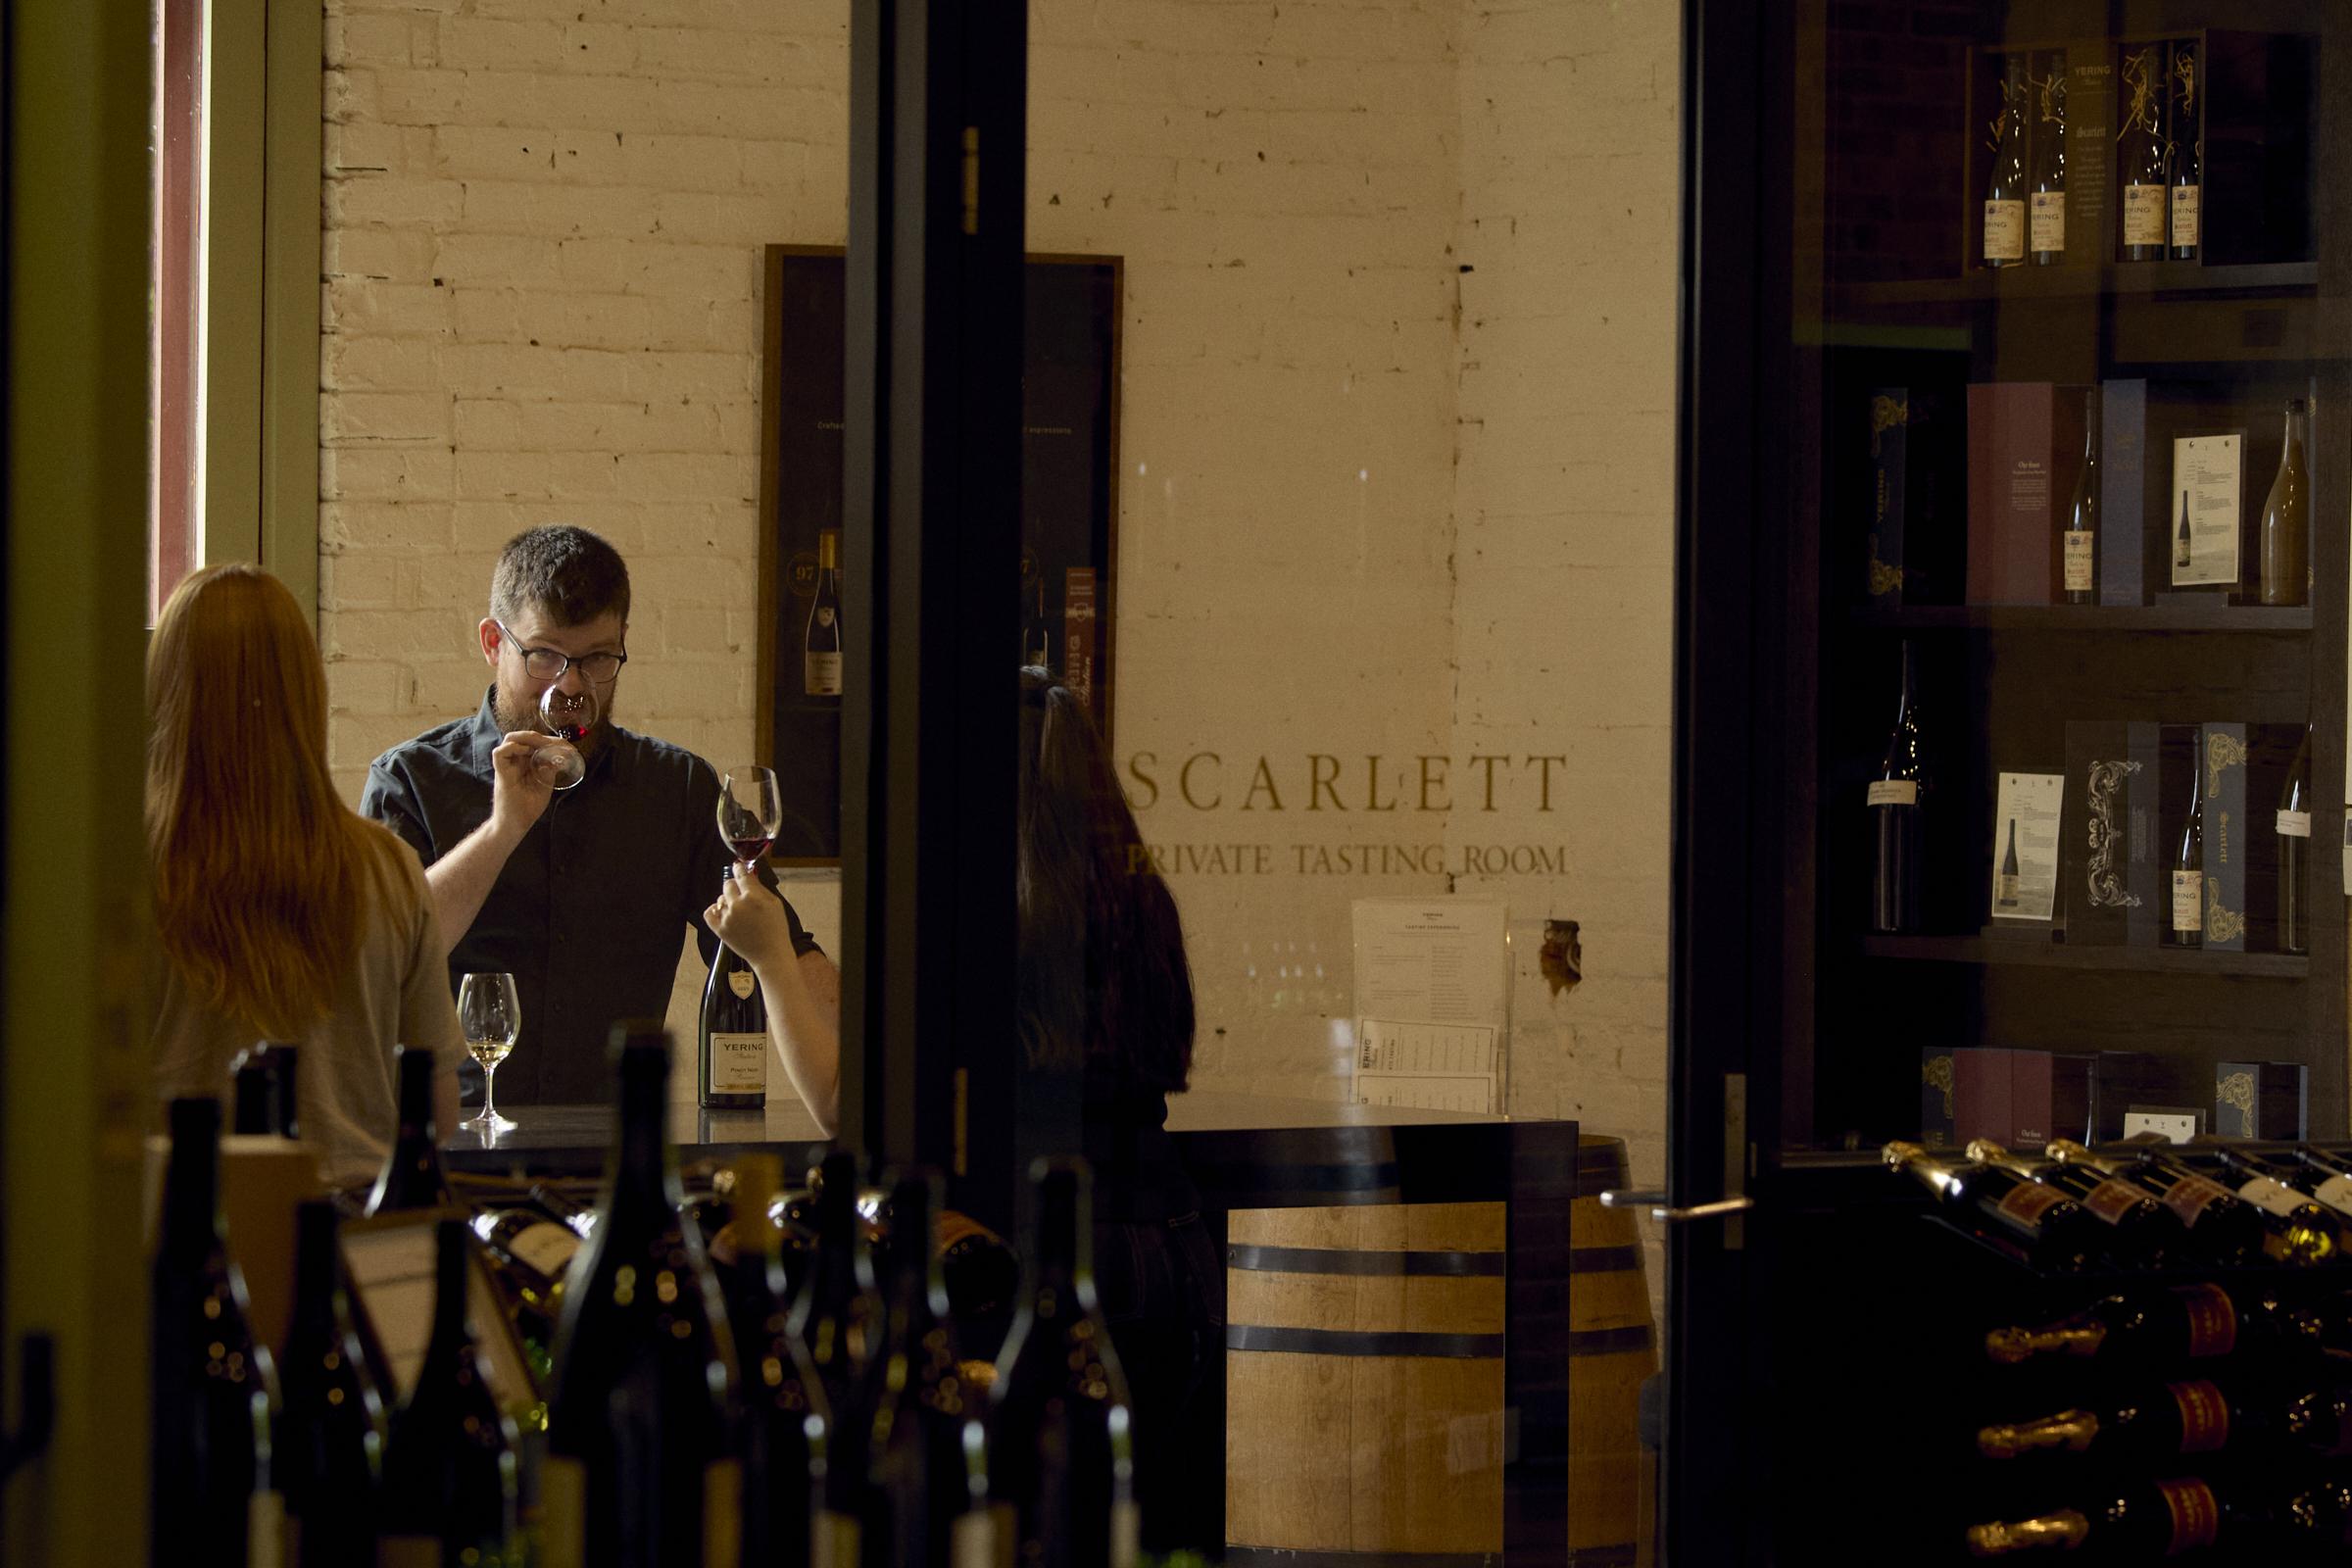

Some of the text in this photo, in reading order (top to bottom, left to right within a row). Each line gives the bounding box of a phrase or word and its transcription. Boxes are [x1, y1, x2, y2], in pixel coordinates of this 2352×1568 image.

[796, 565, 814, 581] 97
[1127, 751, 1566, 811] SCARLETT
[1126, 843, 1568, 875] PRIVATE TASTING ROOM
